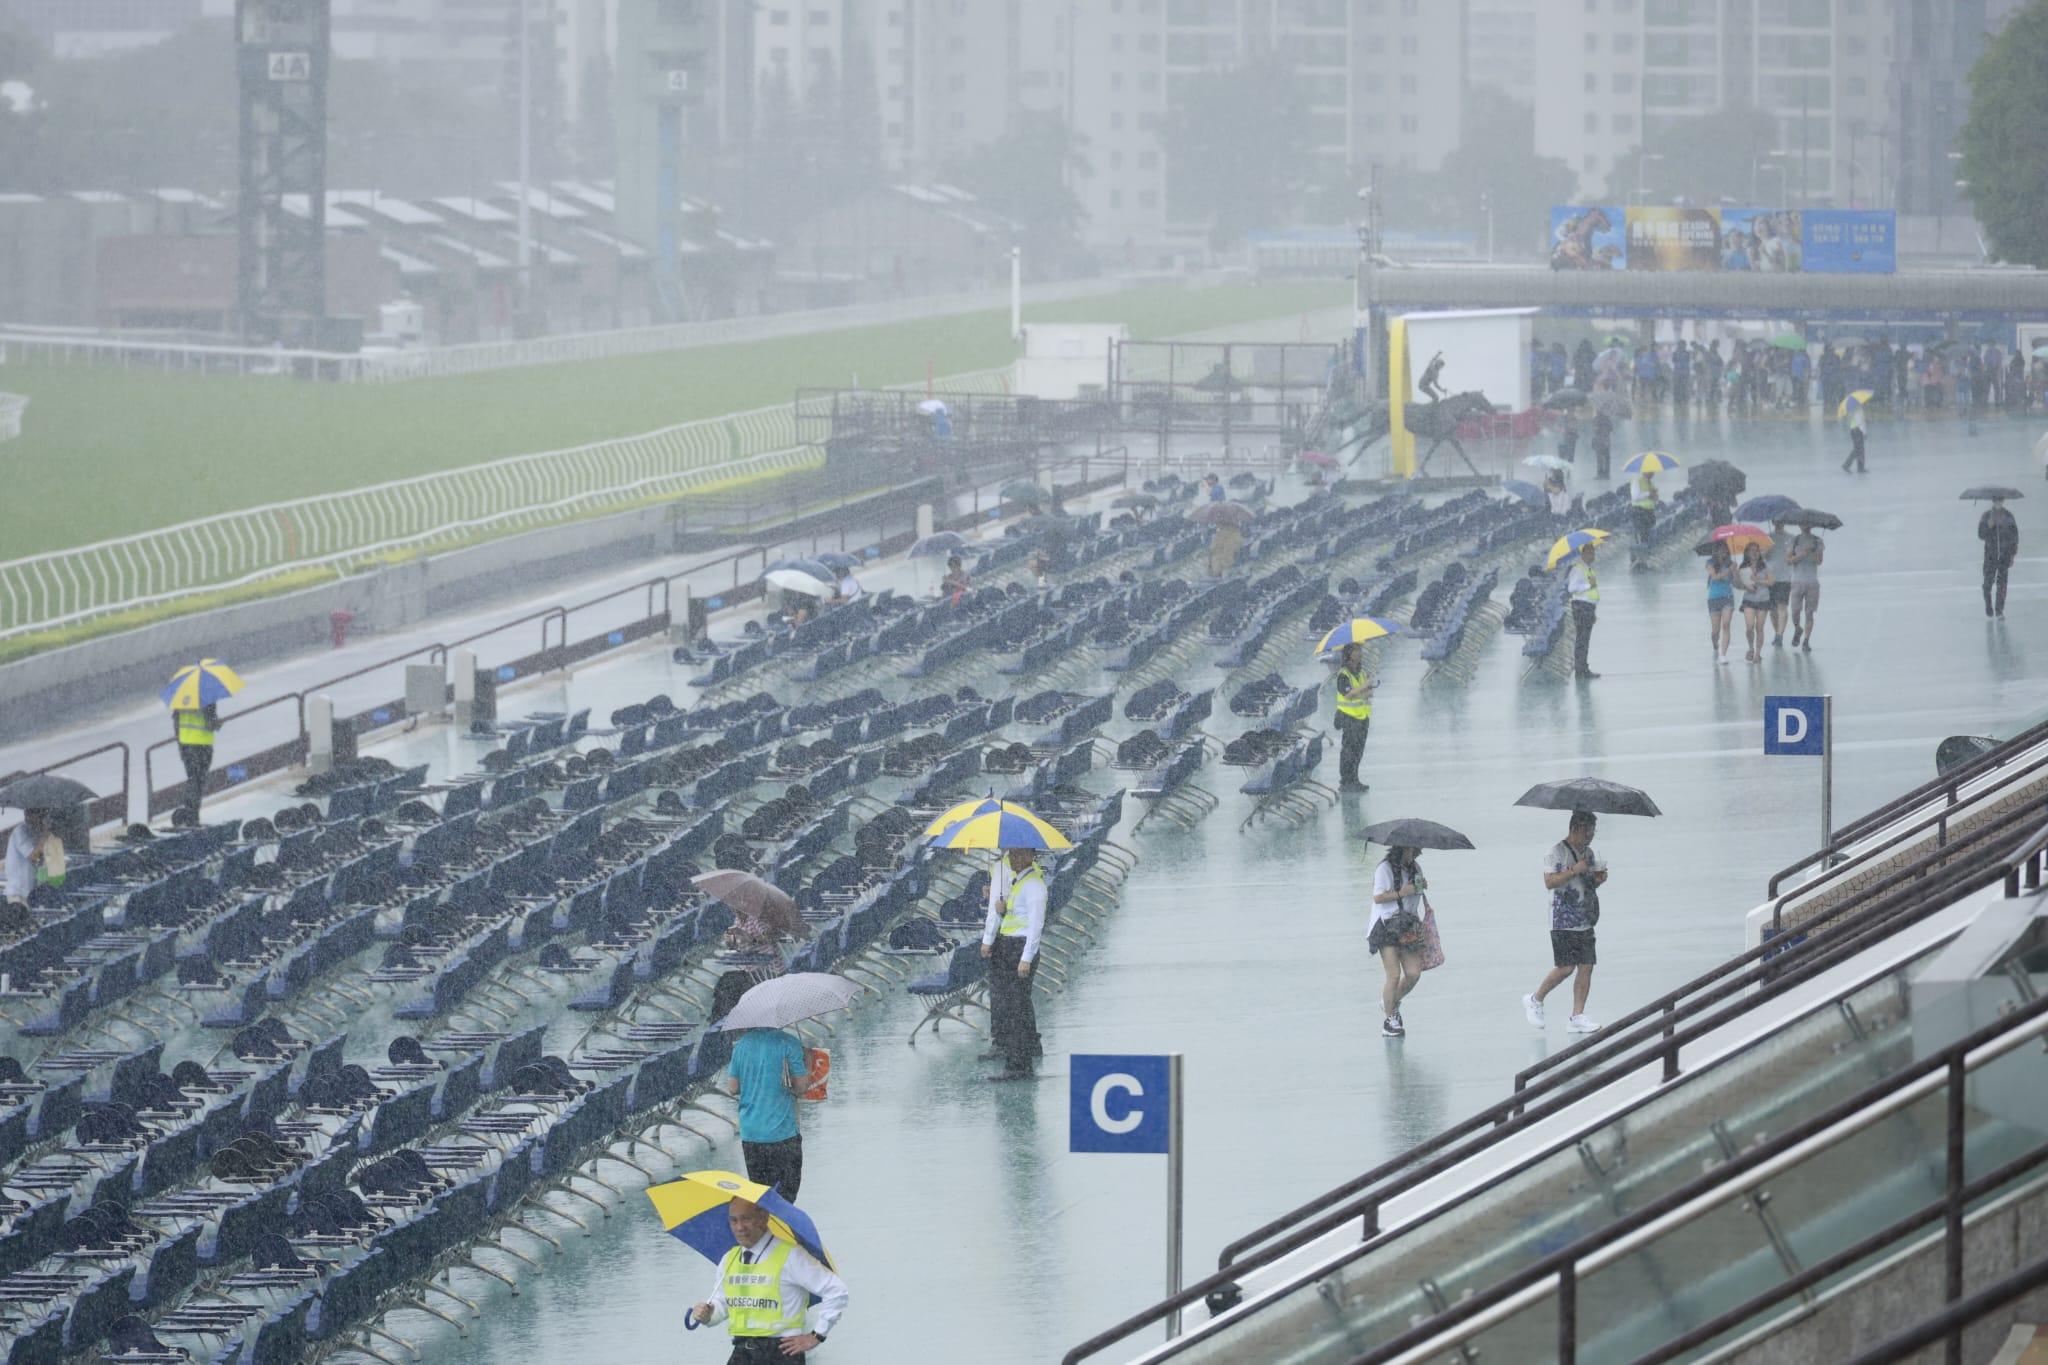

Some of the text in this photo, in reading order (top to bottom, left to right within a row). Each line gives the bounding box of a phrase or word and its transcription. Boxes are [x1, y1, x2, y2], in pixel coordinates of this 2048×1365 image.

[272, 55, 305, 77] 4A
[671, 72, 684, 88] 4
[1777, 707, 1808, 743] D
[1090, 1072, 1144, 1135] C
